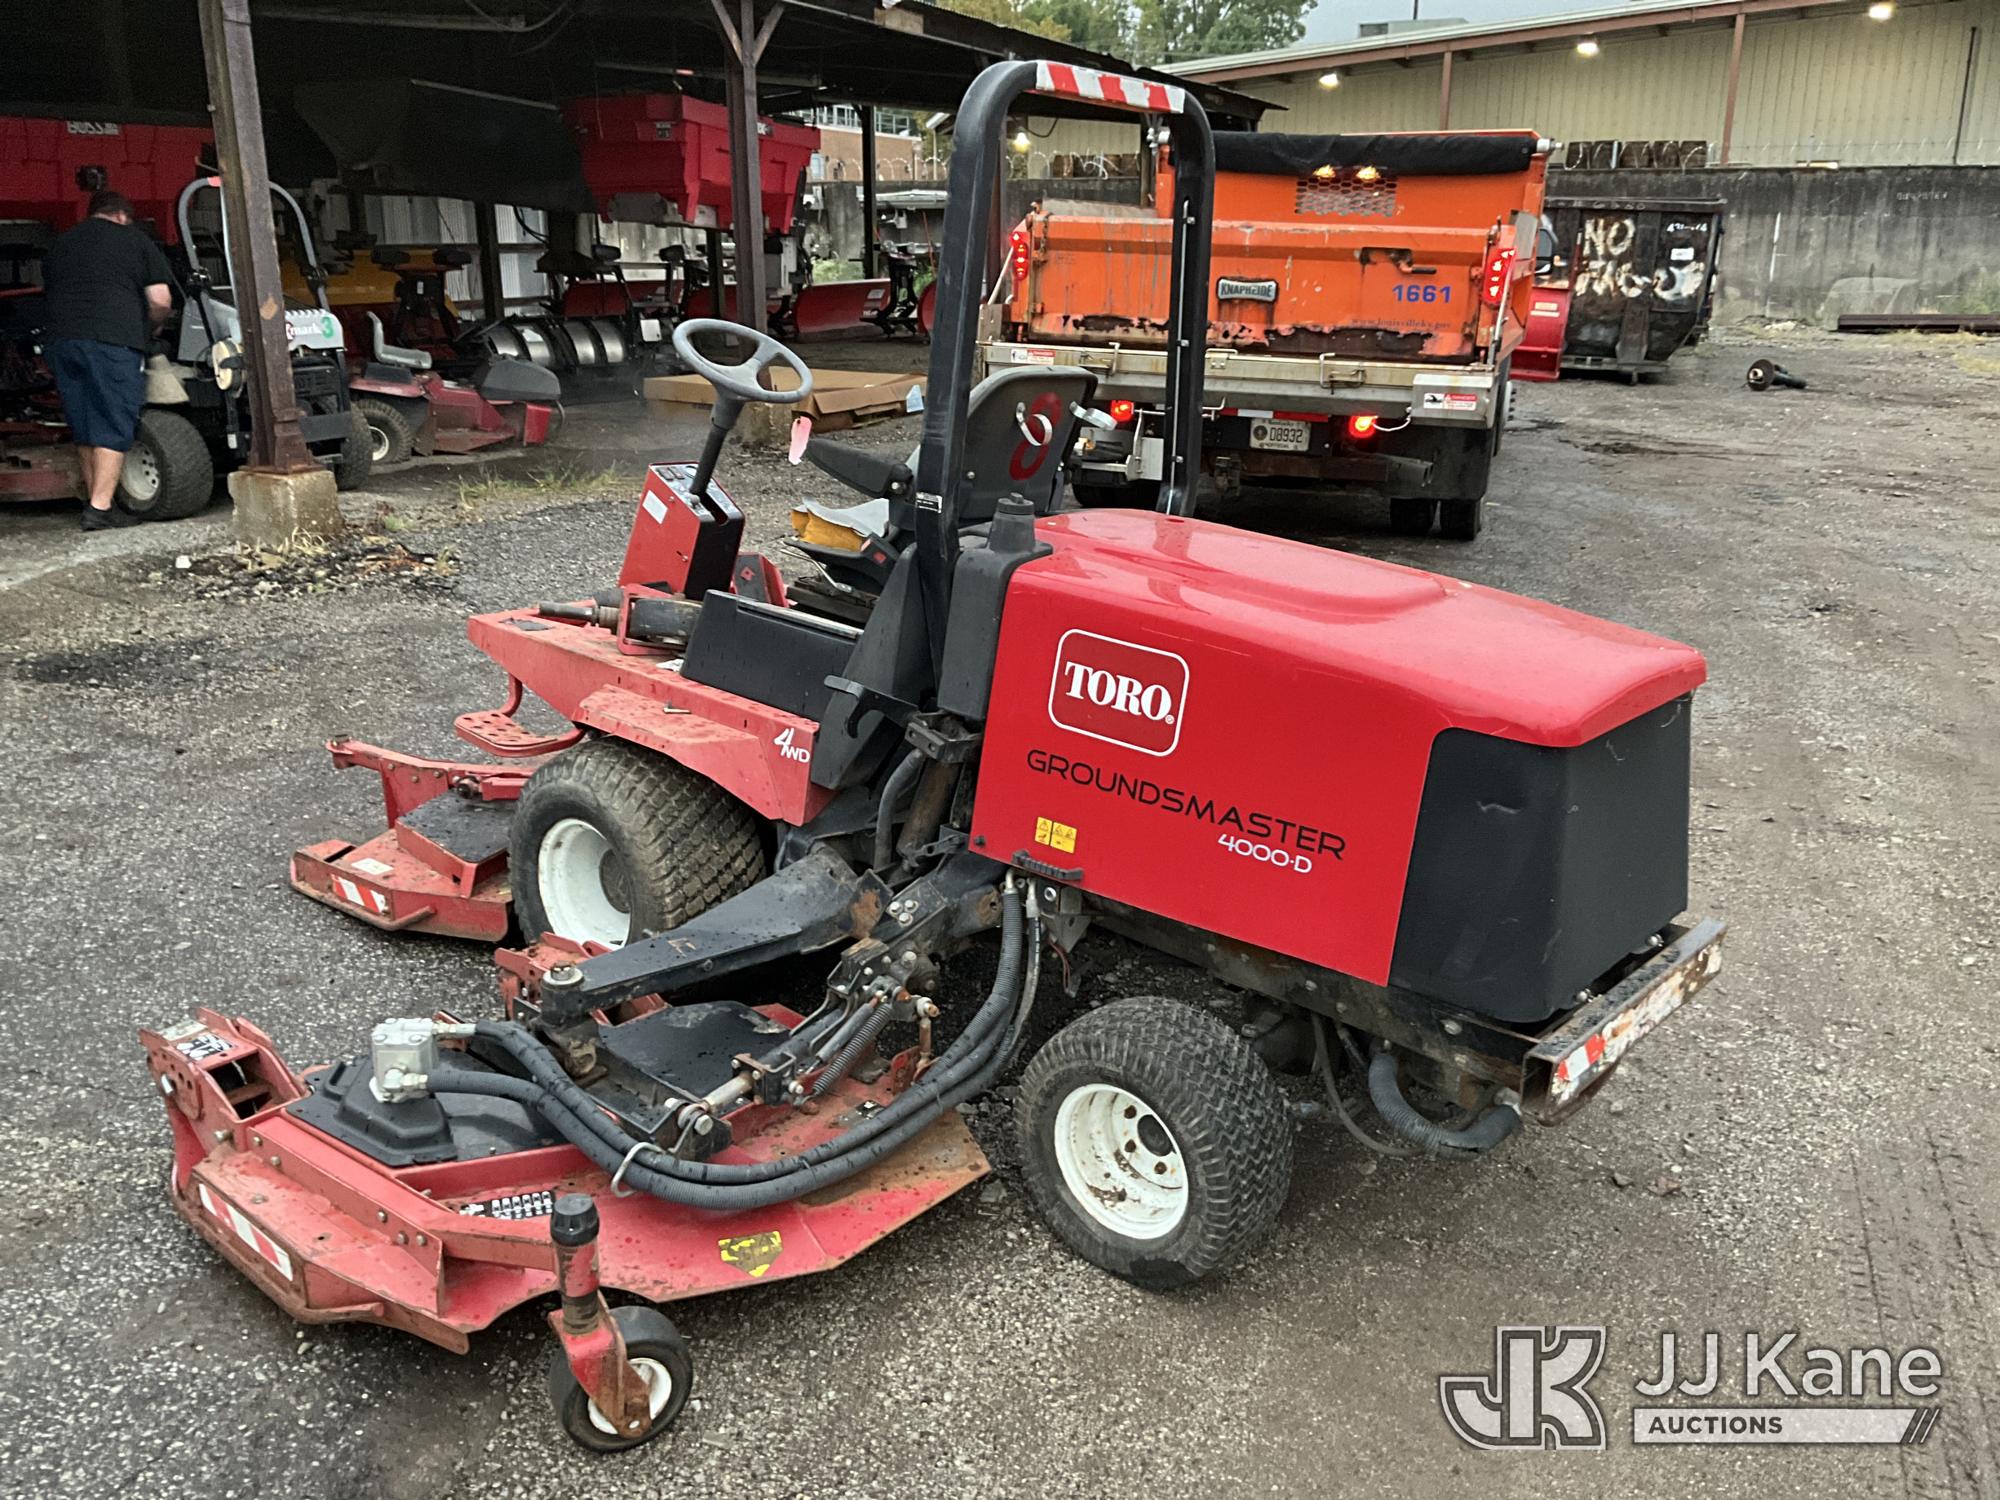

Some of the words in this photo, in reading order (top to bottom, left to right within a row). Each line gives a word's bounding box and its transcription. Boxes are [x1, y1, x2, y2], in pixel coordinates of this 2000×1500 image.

[1583, 217, 1636, 257] NO
[1221, 283, 1273, 298] KNAPHEIDE
[1392, 284, 1452, 304] 1661
[321, 316, 335, 339] 3
[774, 727, 810, 763] 4WD
[1027, 749, 1346, 860] GROUNDSMASTER
